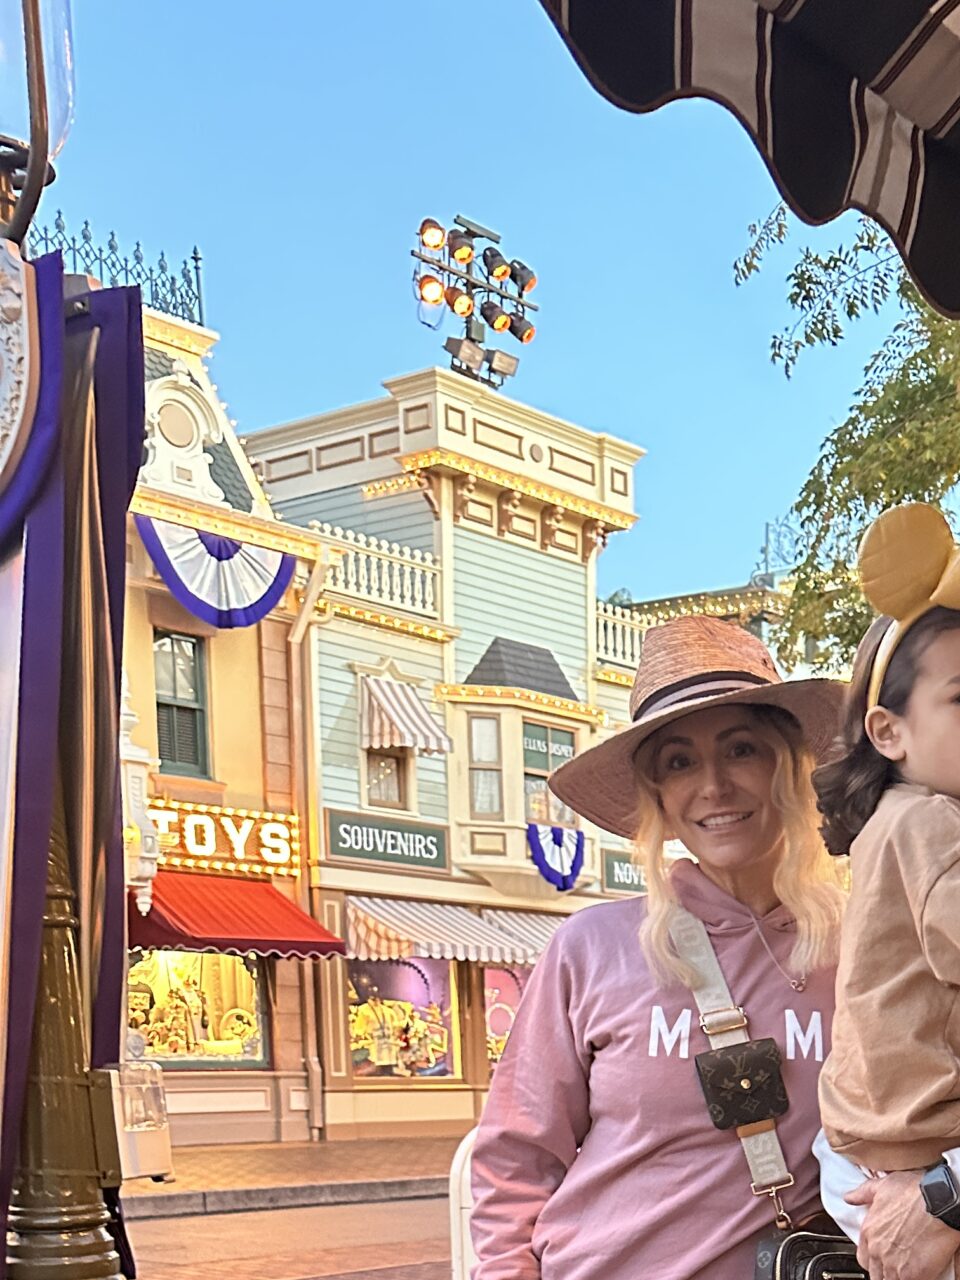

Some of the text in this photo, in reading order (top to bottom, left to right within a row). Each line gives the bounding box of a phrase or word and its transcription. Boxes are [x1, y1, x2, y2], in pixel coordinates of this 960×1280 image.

[523, 737, 548, 753] ELIAS
[146, 809, 291, 864] TOYS
[338, 823, 438, 859] SOUVENIRS
[648, 1005, 824, 1062] MM
